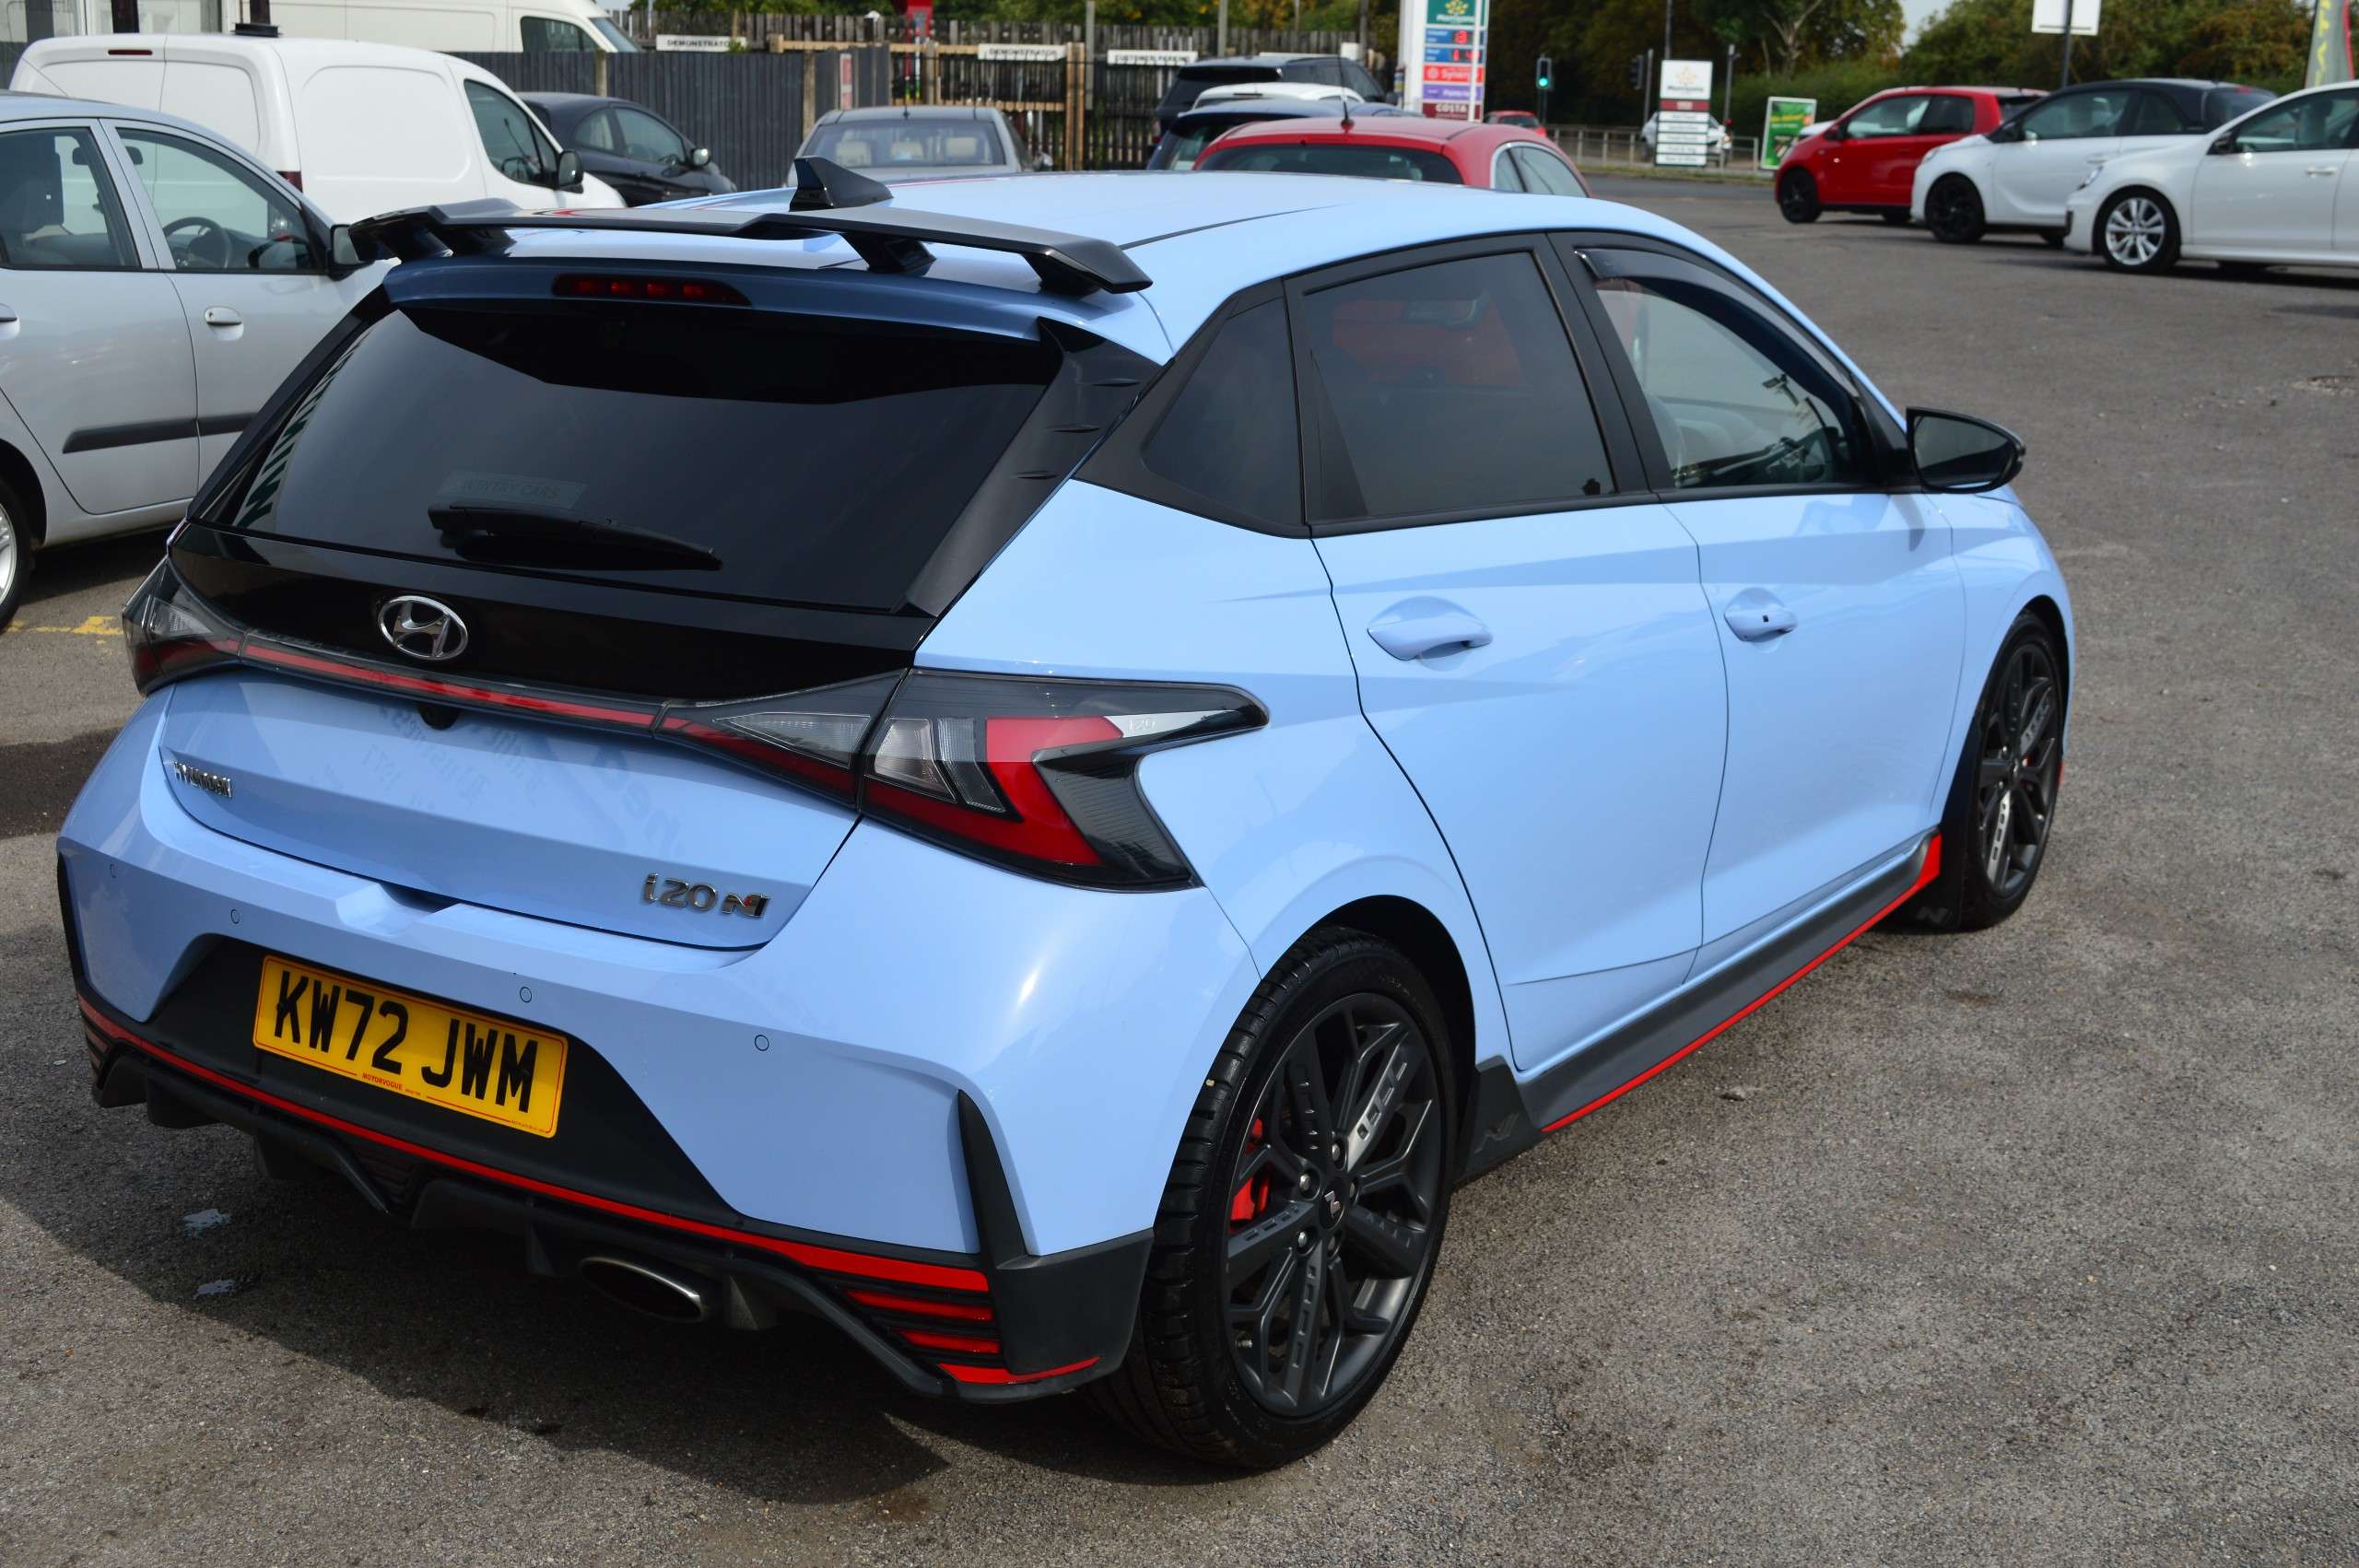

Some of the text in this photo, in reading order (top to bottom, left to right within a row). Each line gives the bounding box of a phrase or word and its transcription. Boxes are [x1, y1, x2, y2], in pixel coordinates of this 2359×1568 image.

[667, 39, 736, 47] DEMONSTRATO
[174, 761, 233, 799] HYUNDAI
[643, 872, 718, 912] i20
[274, 970, 539, 1114] KW72 JWM
[361, 1071, 404, 1092] MOTORVOGUE
